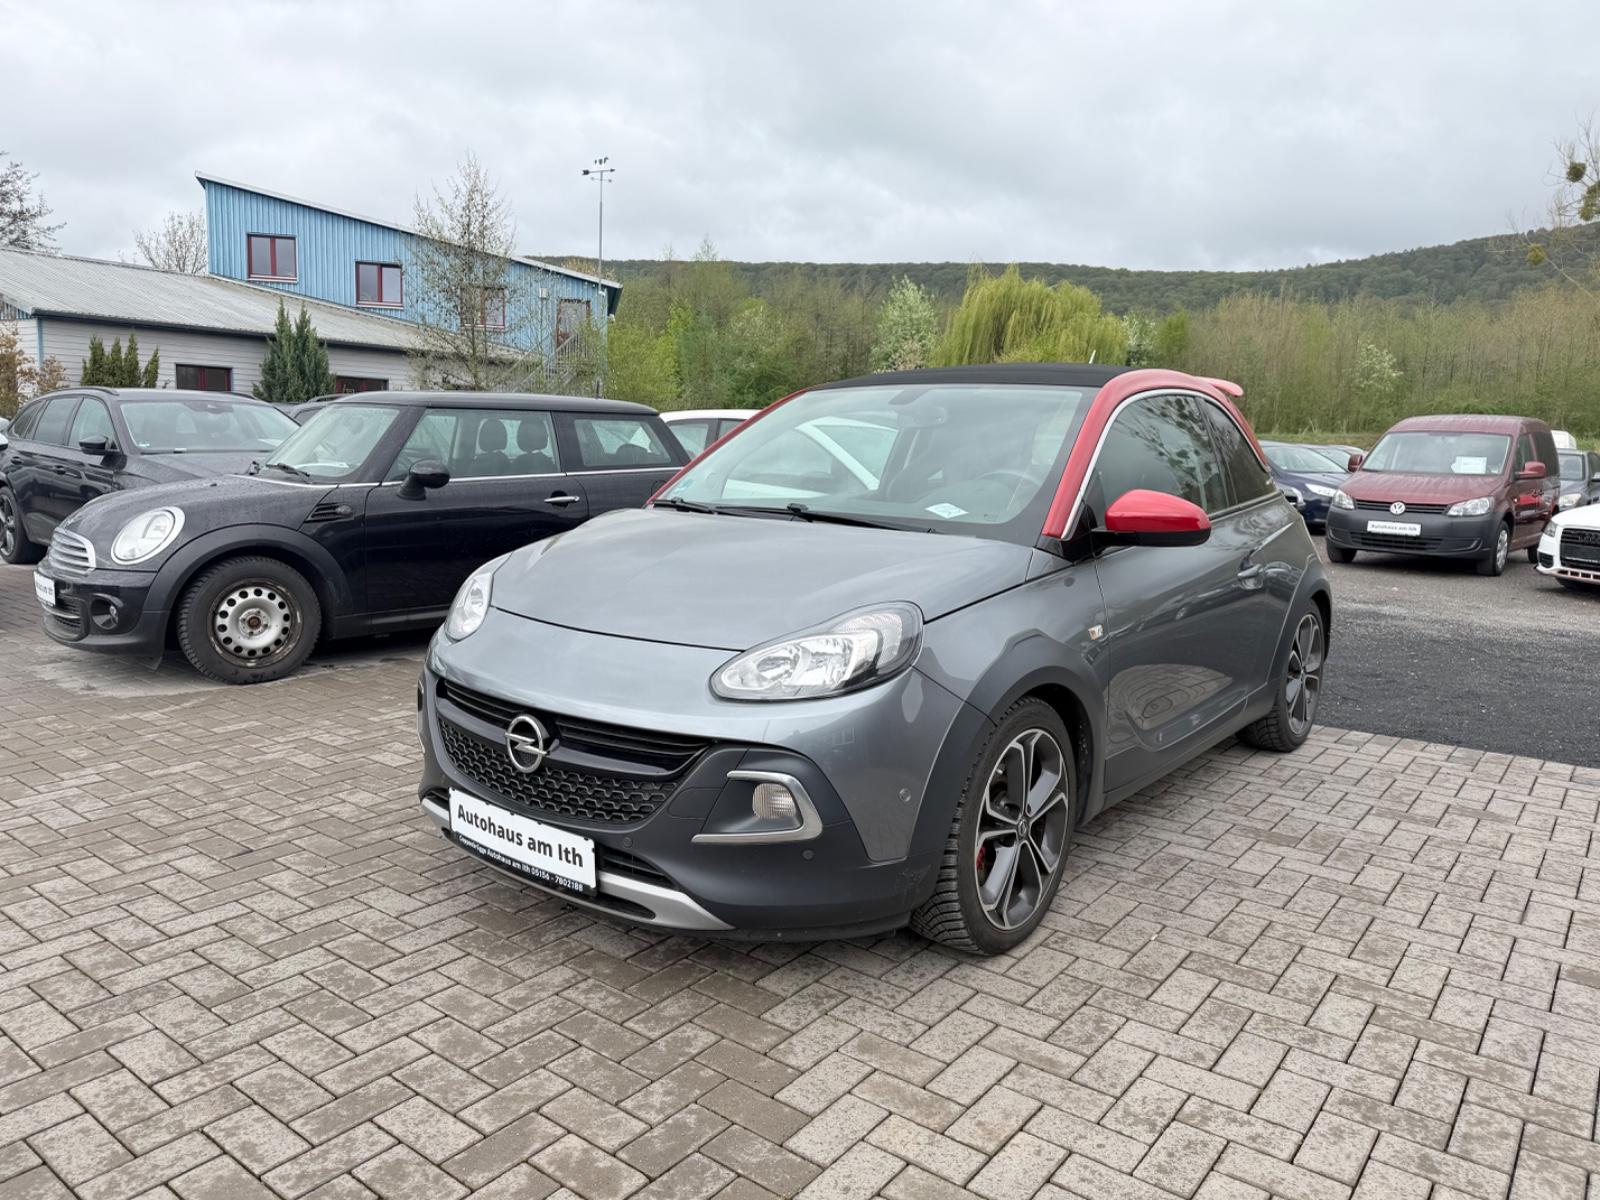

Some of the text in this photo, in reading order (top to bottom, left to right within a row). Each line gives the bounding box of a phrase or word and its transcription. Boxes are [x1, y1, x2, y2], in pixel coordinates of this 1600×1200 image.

[457, 804, 583, 868] Autohaus am Ith
